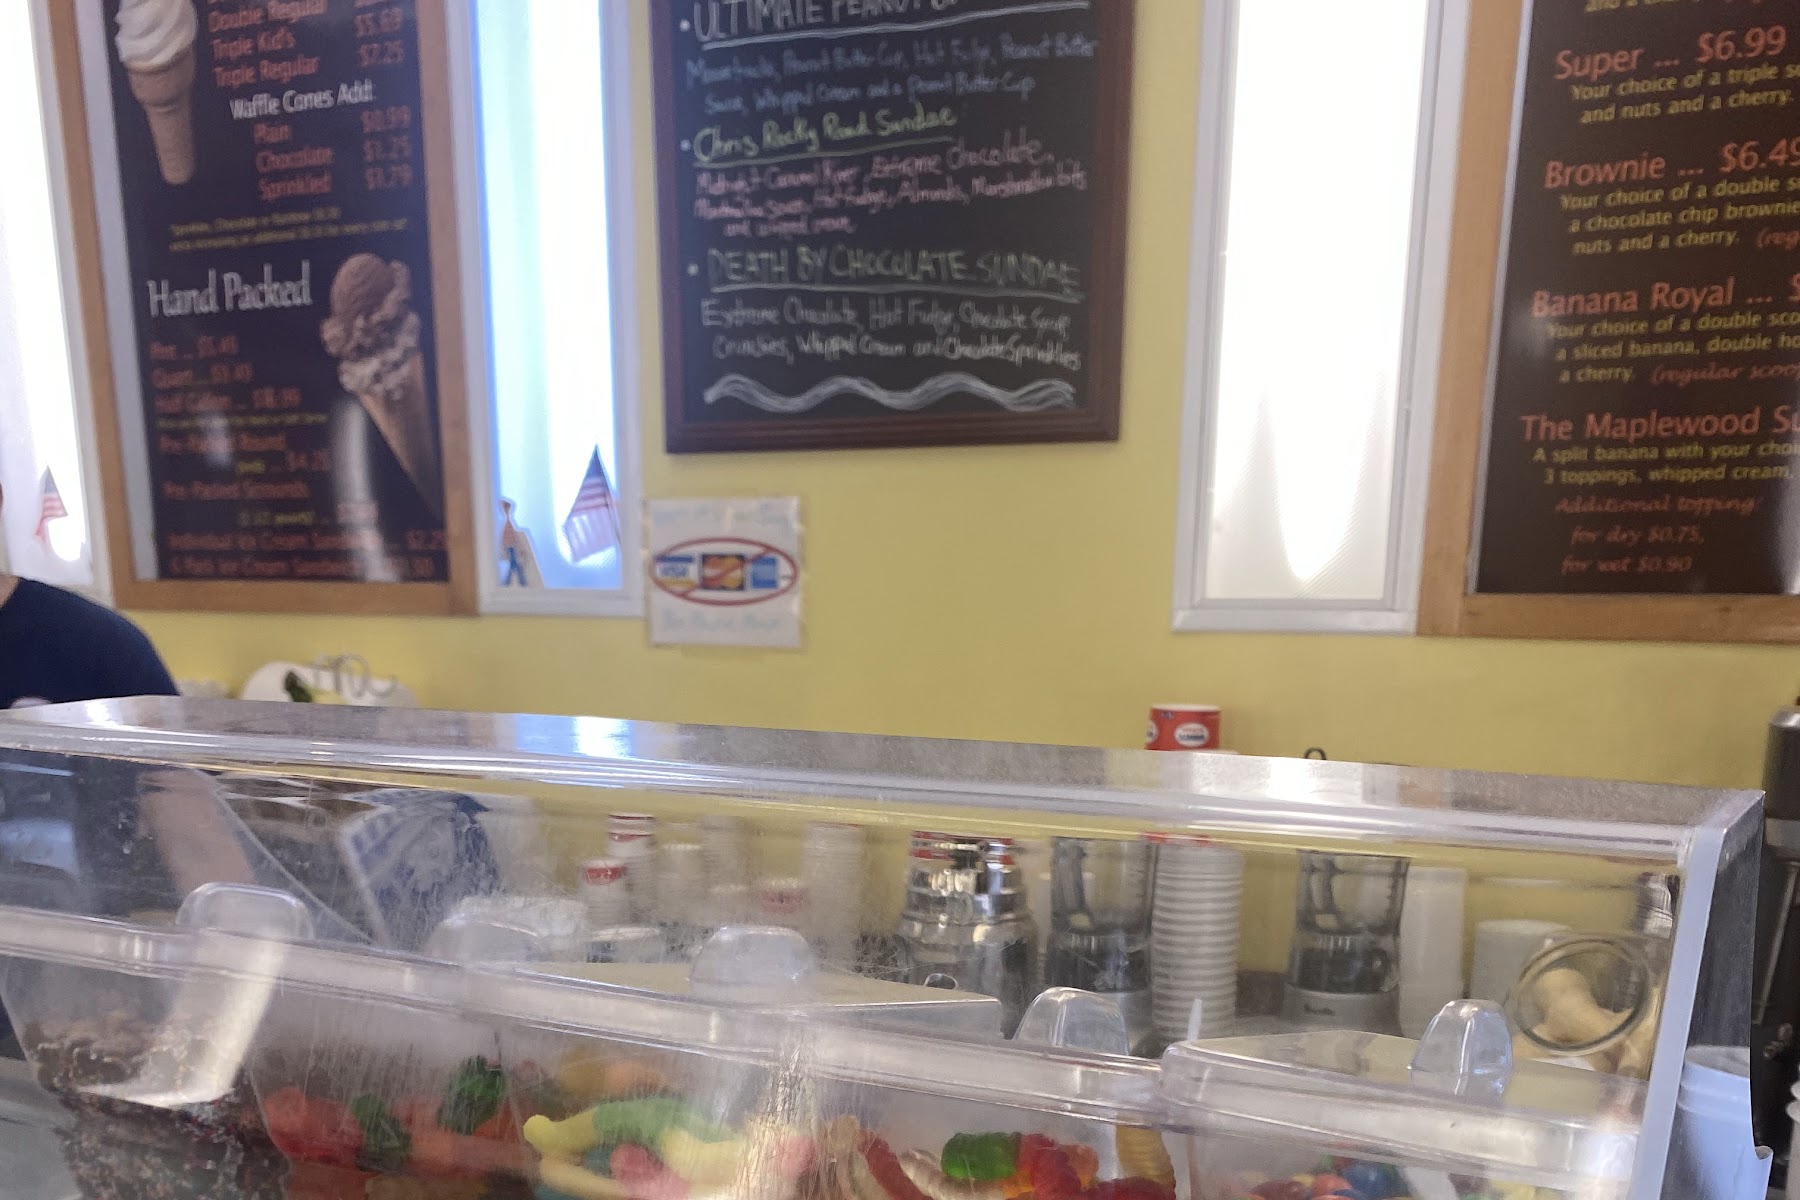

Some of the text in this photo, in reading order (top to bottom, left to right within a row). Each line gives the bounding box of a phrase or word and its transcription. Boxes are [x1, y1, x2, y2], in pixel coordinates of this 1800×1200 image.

[1555, 48, 1645, 82] Super
[1695, 24, 1787, 64] $6.99
[259, 54, 320, 84] Regular
[1569, 82, 1611, 101] Your
[1616, 76, 1678, 97] choice
[1682, 68, 1705, 90] of
[1708, 71, 1722, 86] a
[1727, 63, 1779, 85] triple
[229, 92, 281, 120] Waffle
[282, 89, 334, 114] Cones
[1579, 103, 1616, 124] and
[1620, 102, 1662, 119] nuts
[1667, 95, 1705, 115] and
[1708, 96, 1722, 111] a
[1544, 152, 1667, 190] Brownie
[1719, 136, 1800, 175] $6.49
[1560, 194, 1599, 212] Your
[1604, 188, 1665, 208] choice
[1668, 181, 1691, 201] of
[1695, 184, 1708, 199] a
[1711, 176, 1781, 198] double
[1568, 218, 1581, 233] a
[1584, 209, 1673, 232] chocolate
[1677, 205, 1720, 225] chip
[1572, 239, 1613, 256] nuts
[1617, 233, 1654, 252] and
[1658, 234, 1670, 250] a
[708, 247, 790, 285] DEATH
[829, 243, 975, 284] CHOCOLATE
[147, 259, 312, 317] Hand Packed
[1531, 289, 1640, 319] Banana
[1649, 275, 1736, 314] Royal
[1590, 317, 1649, 338] choice
[1655, 313, 1676, 334] of
[1679, 317, 1691, 333] a
[1697, 309, 1762, 331] double
[1555, 349, 1568, 363] a
[1573, 340, 1624, 361] sliced
[1706, 331, 1773, 354] double
[1558, 368, 1571, 384] a
[1520, 411, 1575, 443] The
[1583, 402, 1762, 445] Maplewood
[1530, 446, 1547, 464] A
[1595, 443, 1660, 462] banana
[1664, 439, 1704, 459] with
[1710, 441, 1751, 461] your
[1648, 463, 1726, 483] whipped
